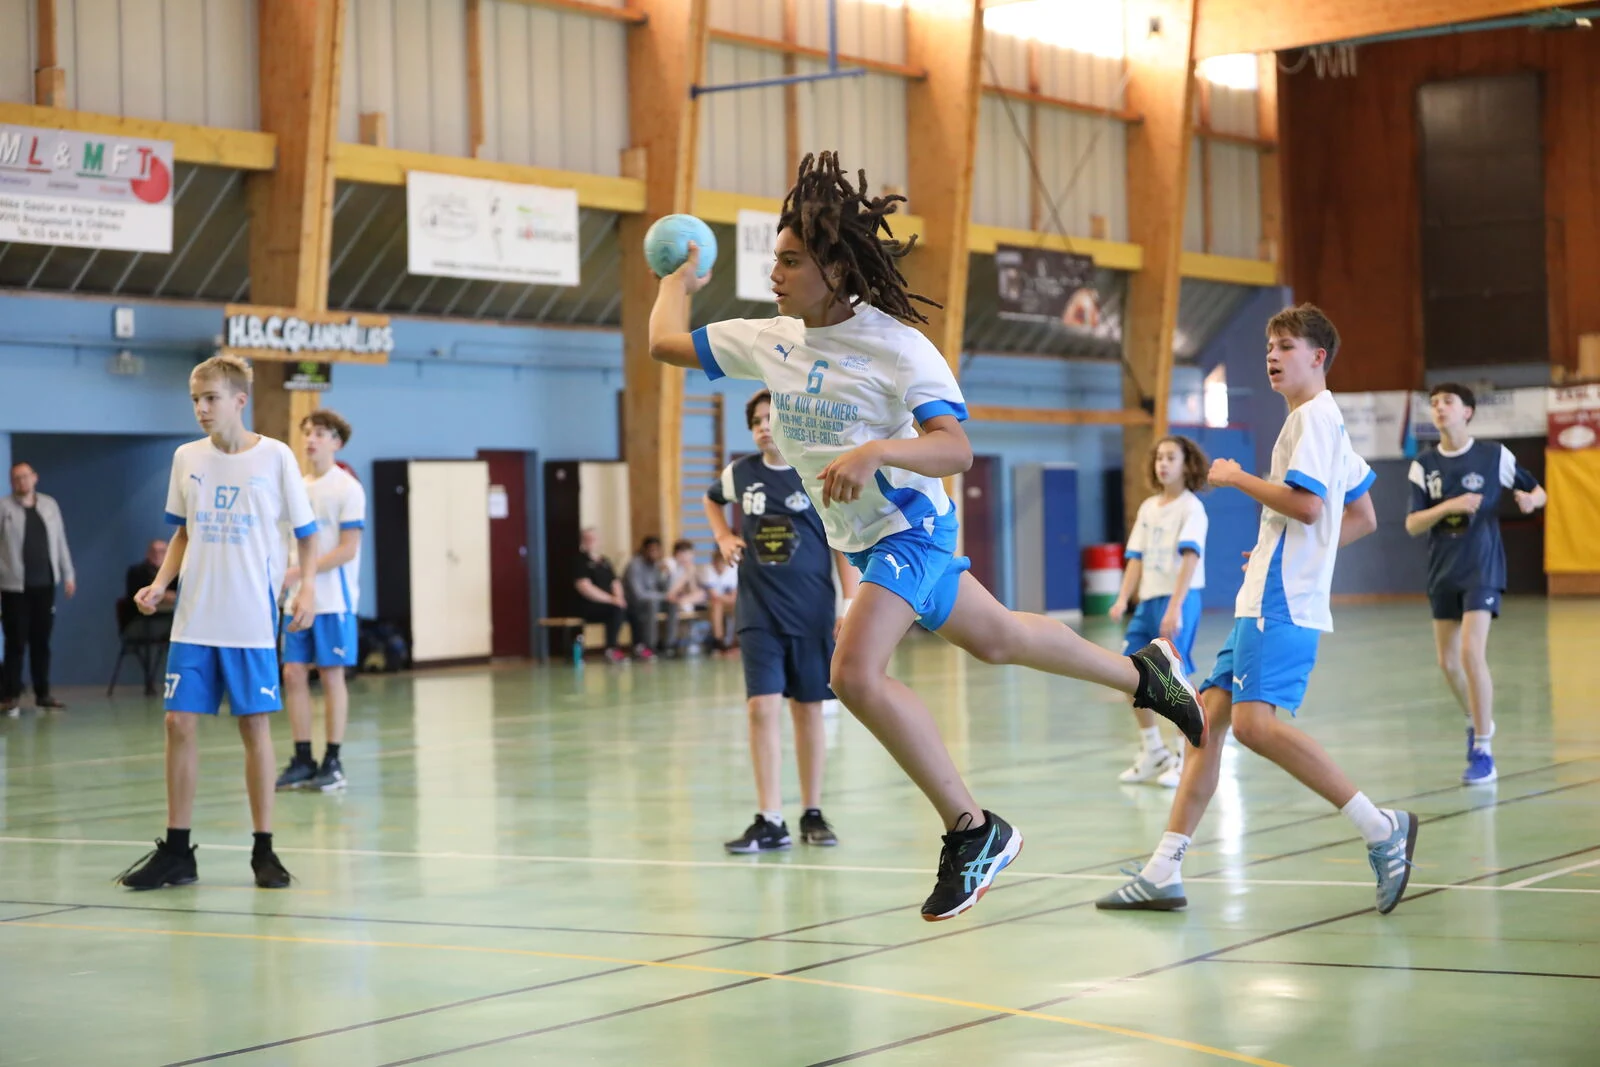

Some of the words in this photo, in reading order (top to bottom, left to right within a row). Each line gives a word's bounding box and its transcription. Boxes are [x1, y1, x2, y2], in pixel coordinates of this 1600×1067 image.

[806, 359, 829, 395] 6
[771, 391, 790, 411] ABAC
[795, 395, 813, 415] AUX
[815, 399, 858, 421] PALMIERS
[214, 485, 240, 510] 67
